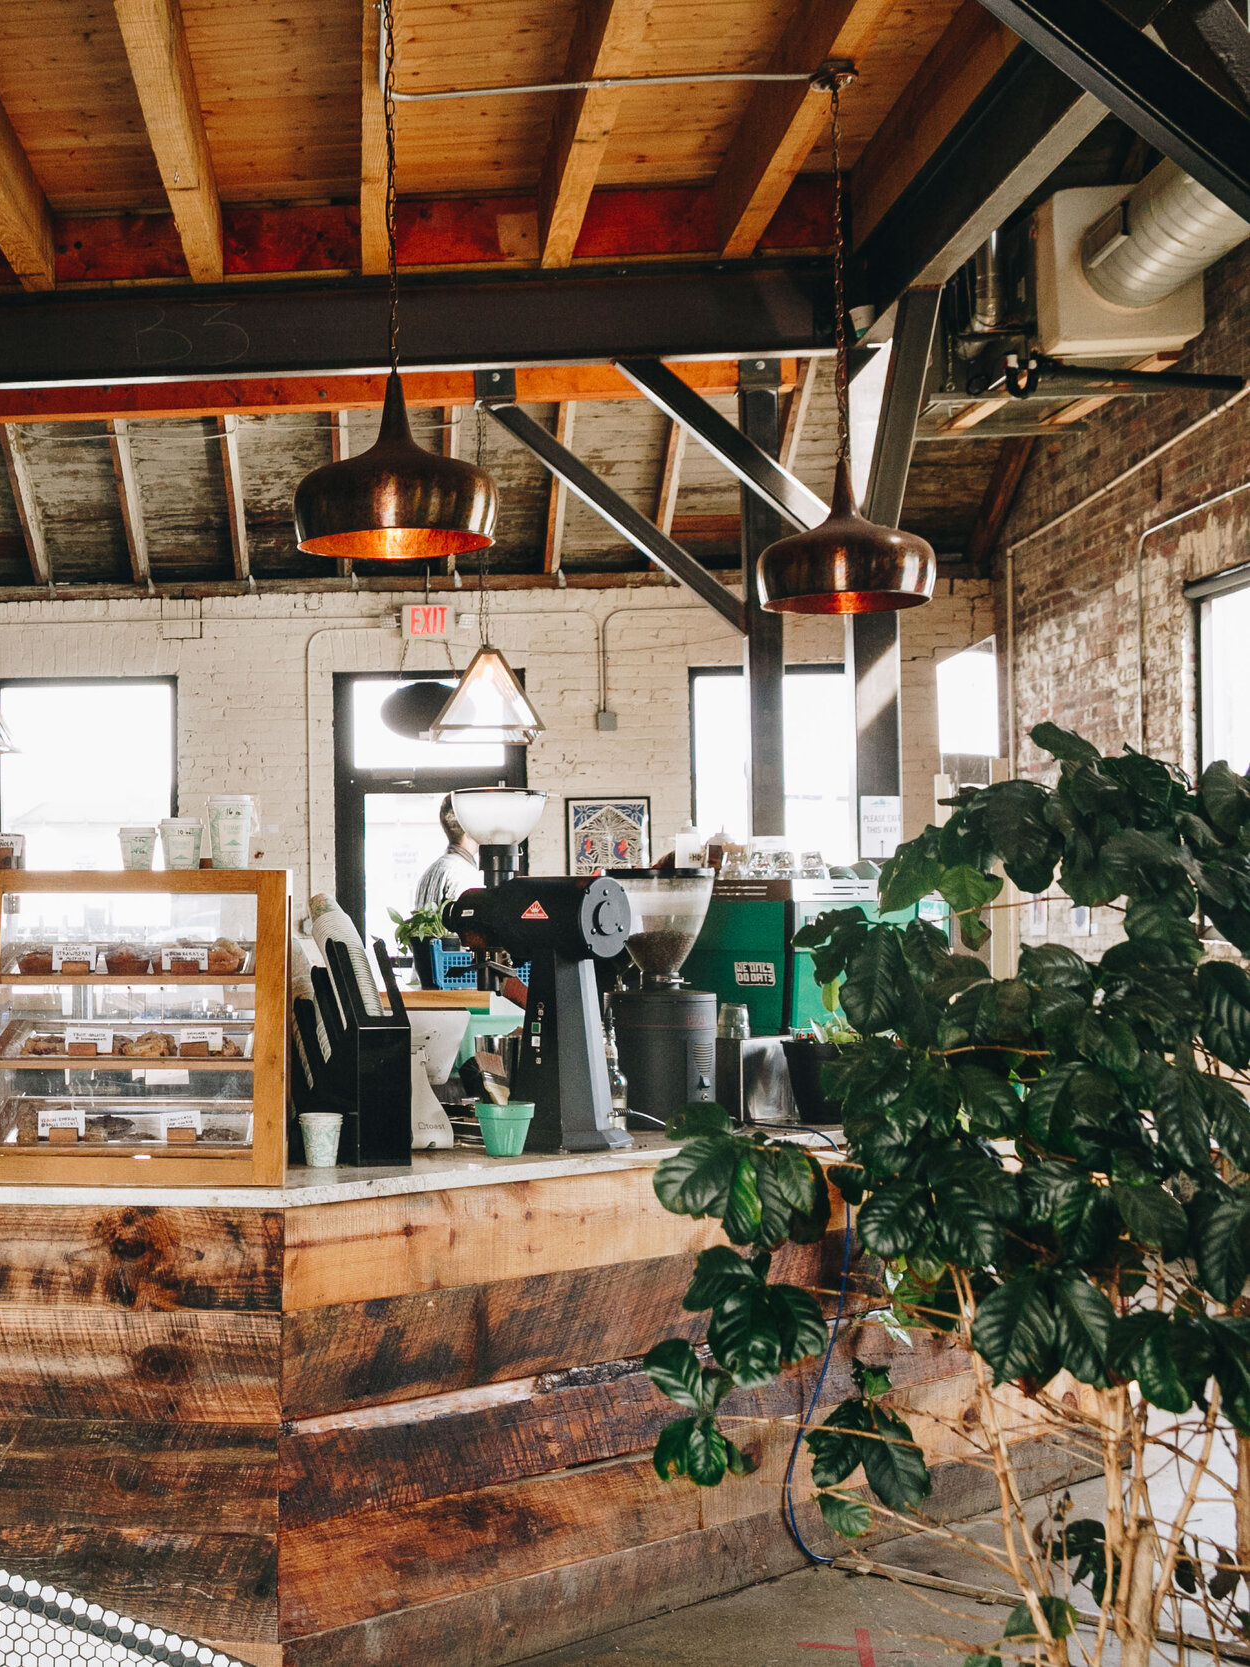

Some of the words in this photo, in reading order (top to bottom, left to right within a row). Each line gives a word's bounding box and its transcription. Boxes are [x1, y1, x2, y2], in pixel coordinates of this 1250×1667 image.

[410, 606, 448, 636] EXIT
[863, 814, 886, 822] PLEASE
[737, 972, 750, 982] DO
[750, 973, 774, 982] OATS
